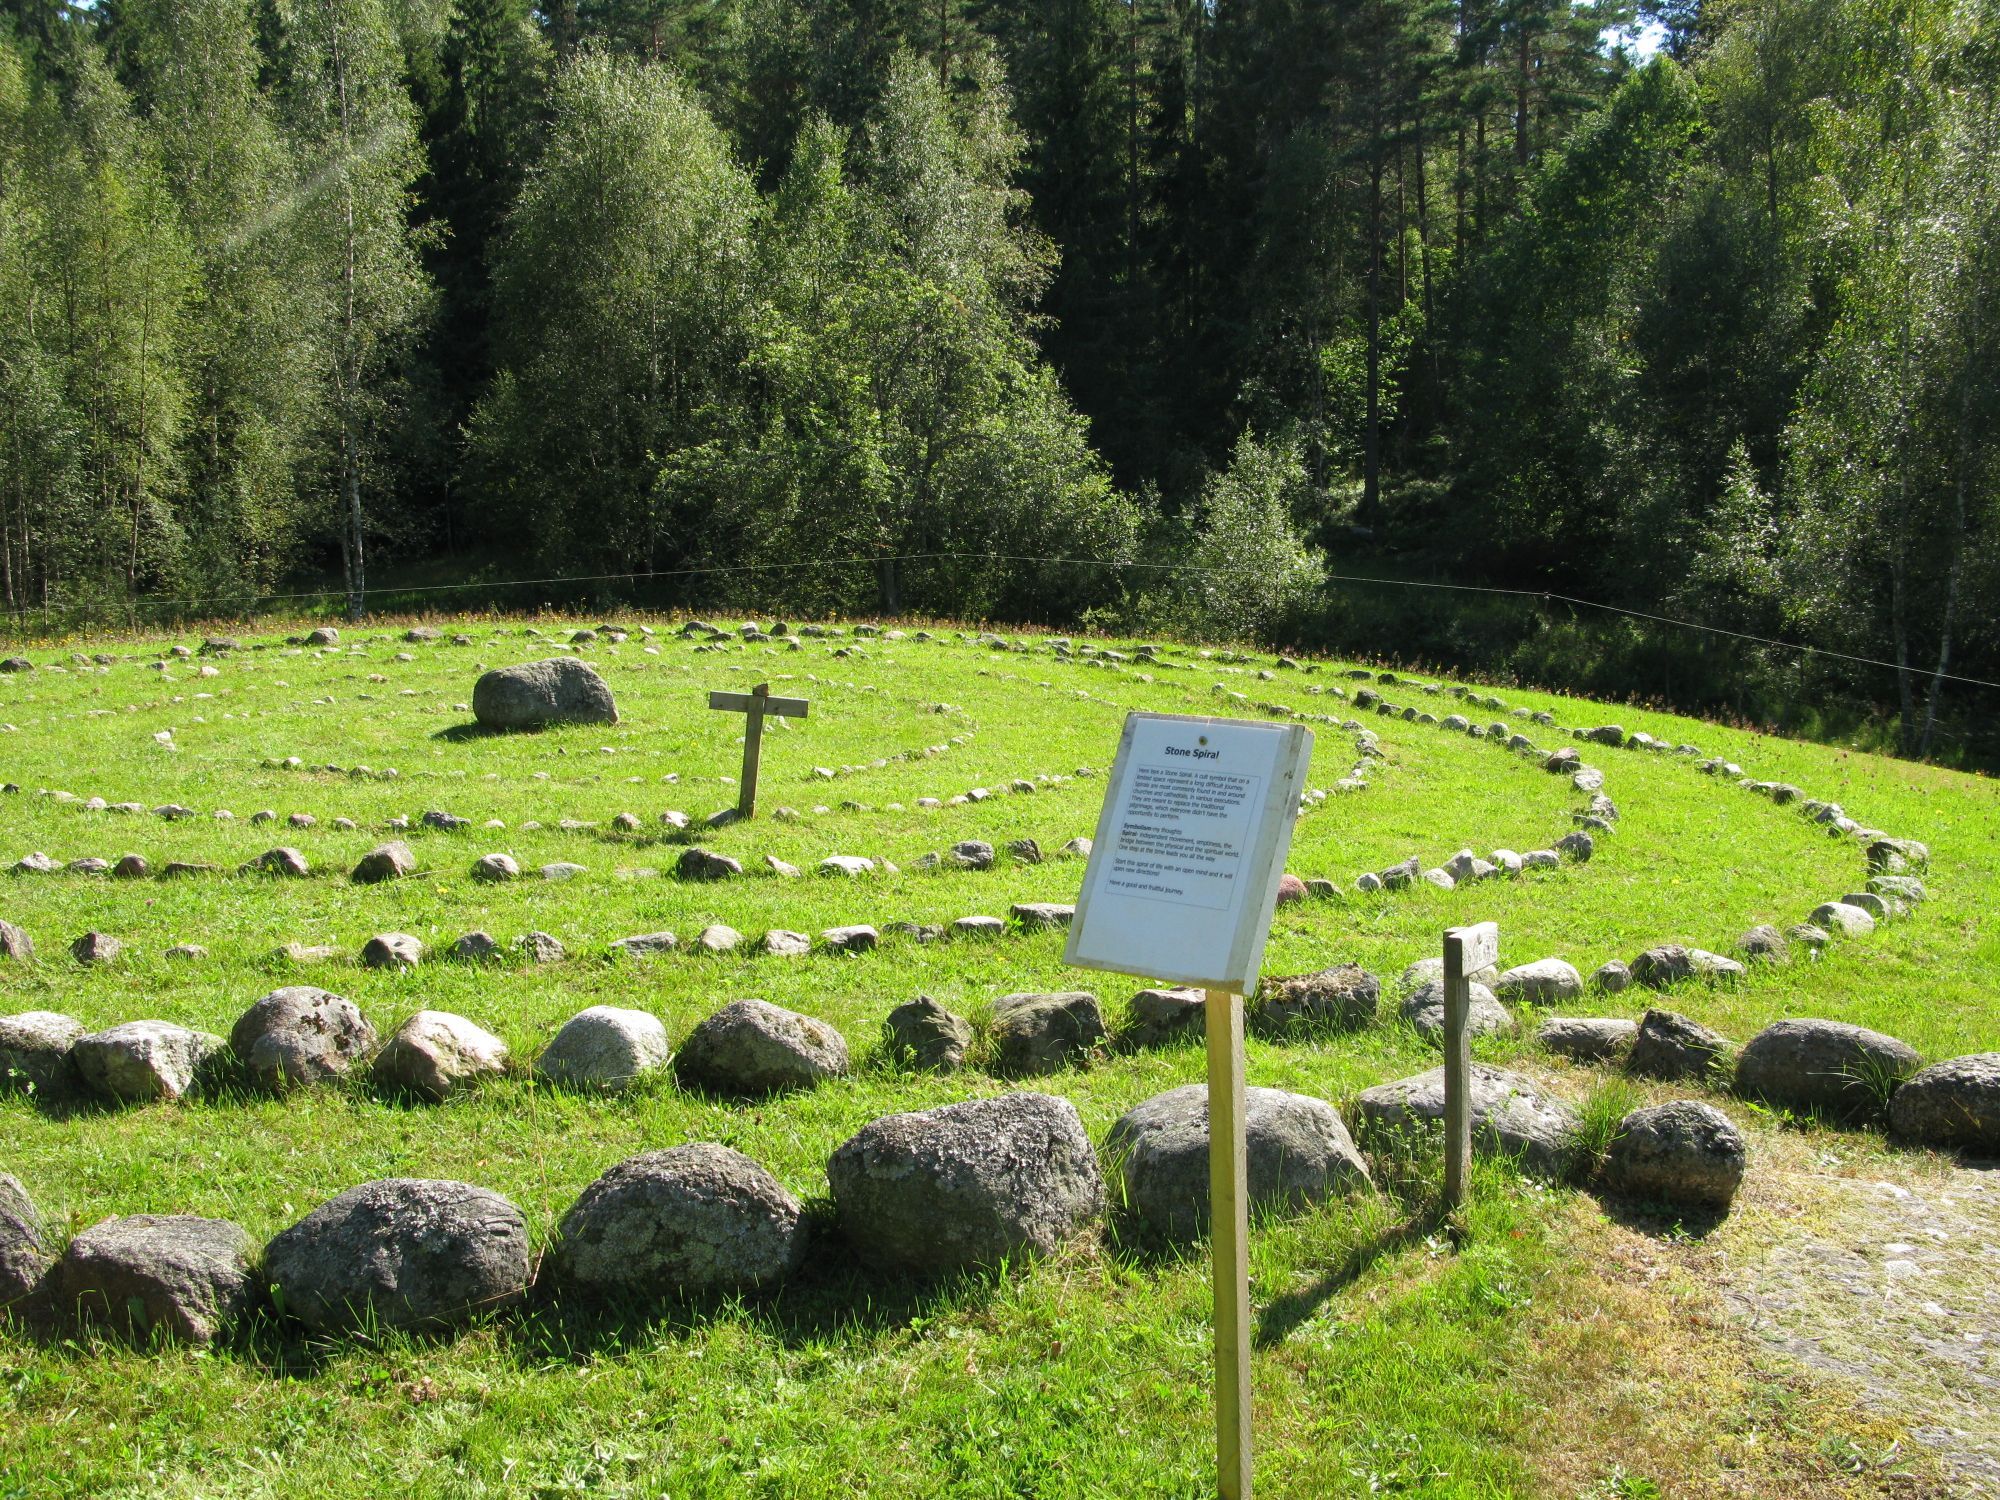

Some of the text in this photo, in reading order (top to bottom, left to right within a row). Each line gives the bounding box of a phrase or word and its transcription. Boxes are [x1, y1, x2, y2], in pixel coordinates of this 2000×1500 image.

[1165, 746, 1219, 760] Stone Spiral
[1127, 809, 1153, 817] opportunity
[1139, 832, 1168, 841] independent
